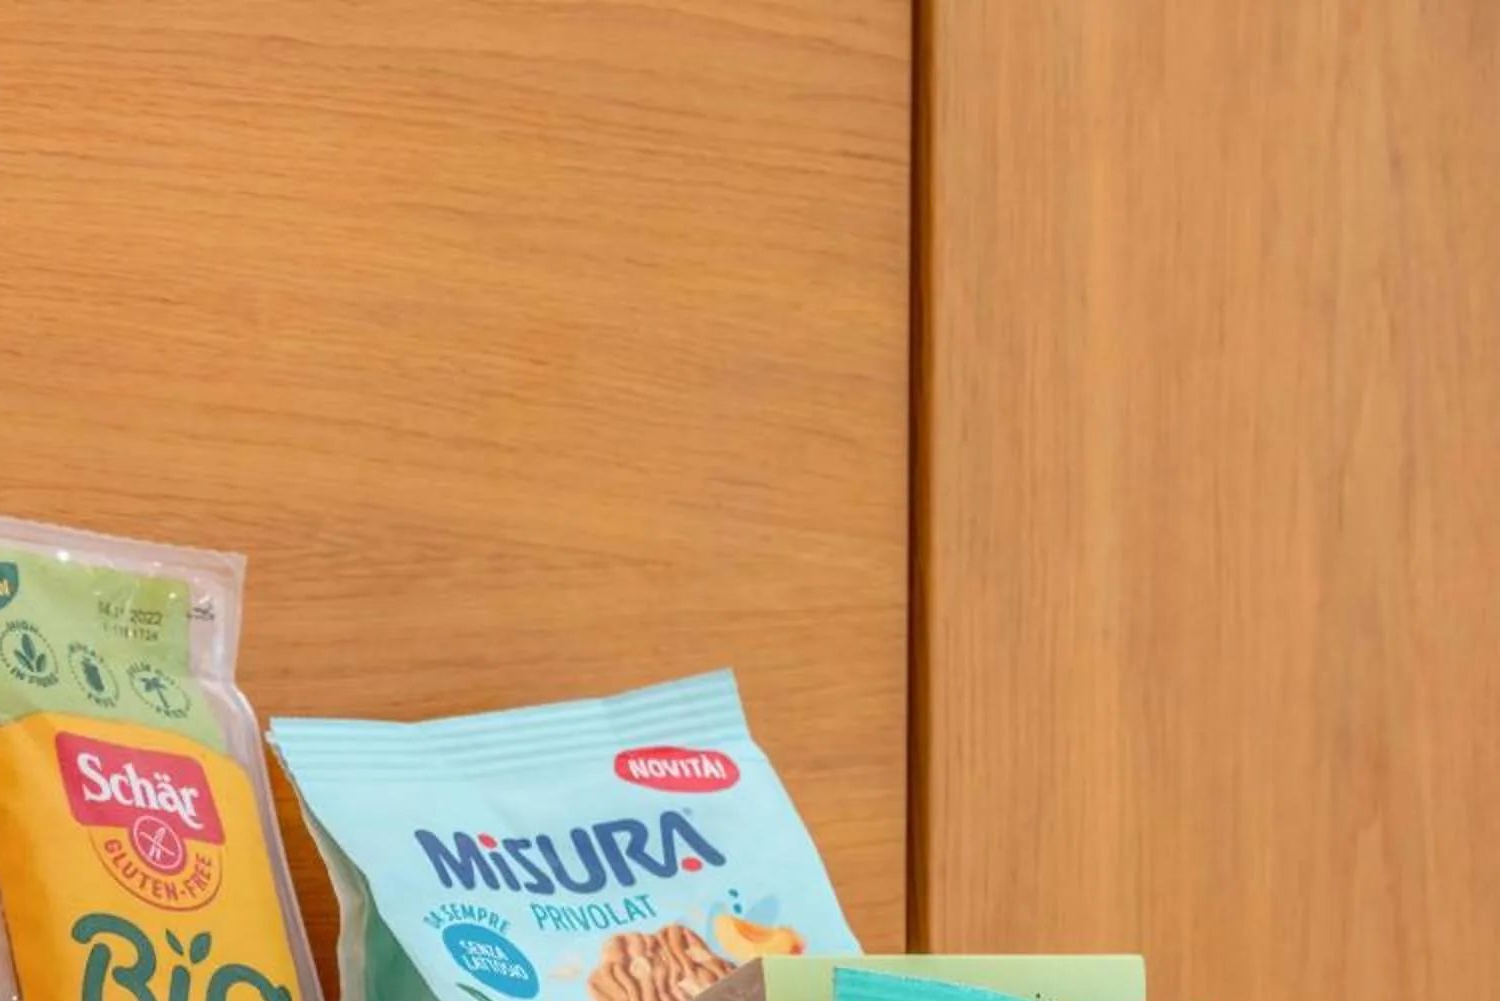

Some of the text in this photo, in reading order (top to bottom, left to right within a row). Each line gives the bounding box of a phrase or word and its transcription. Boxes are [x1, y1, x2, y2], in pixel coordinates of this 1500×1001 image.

[627, 754, 728, 780] NOVITÀ!
[76, 752, 204, 830] Schär
[103, 838, 213, 901] GLUTEN-FREE
[439, 902, 512, 935] SEMPRE
[529, 893, 659, 932] PRIVOLAT
